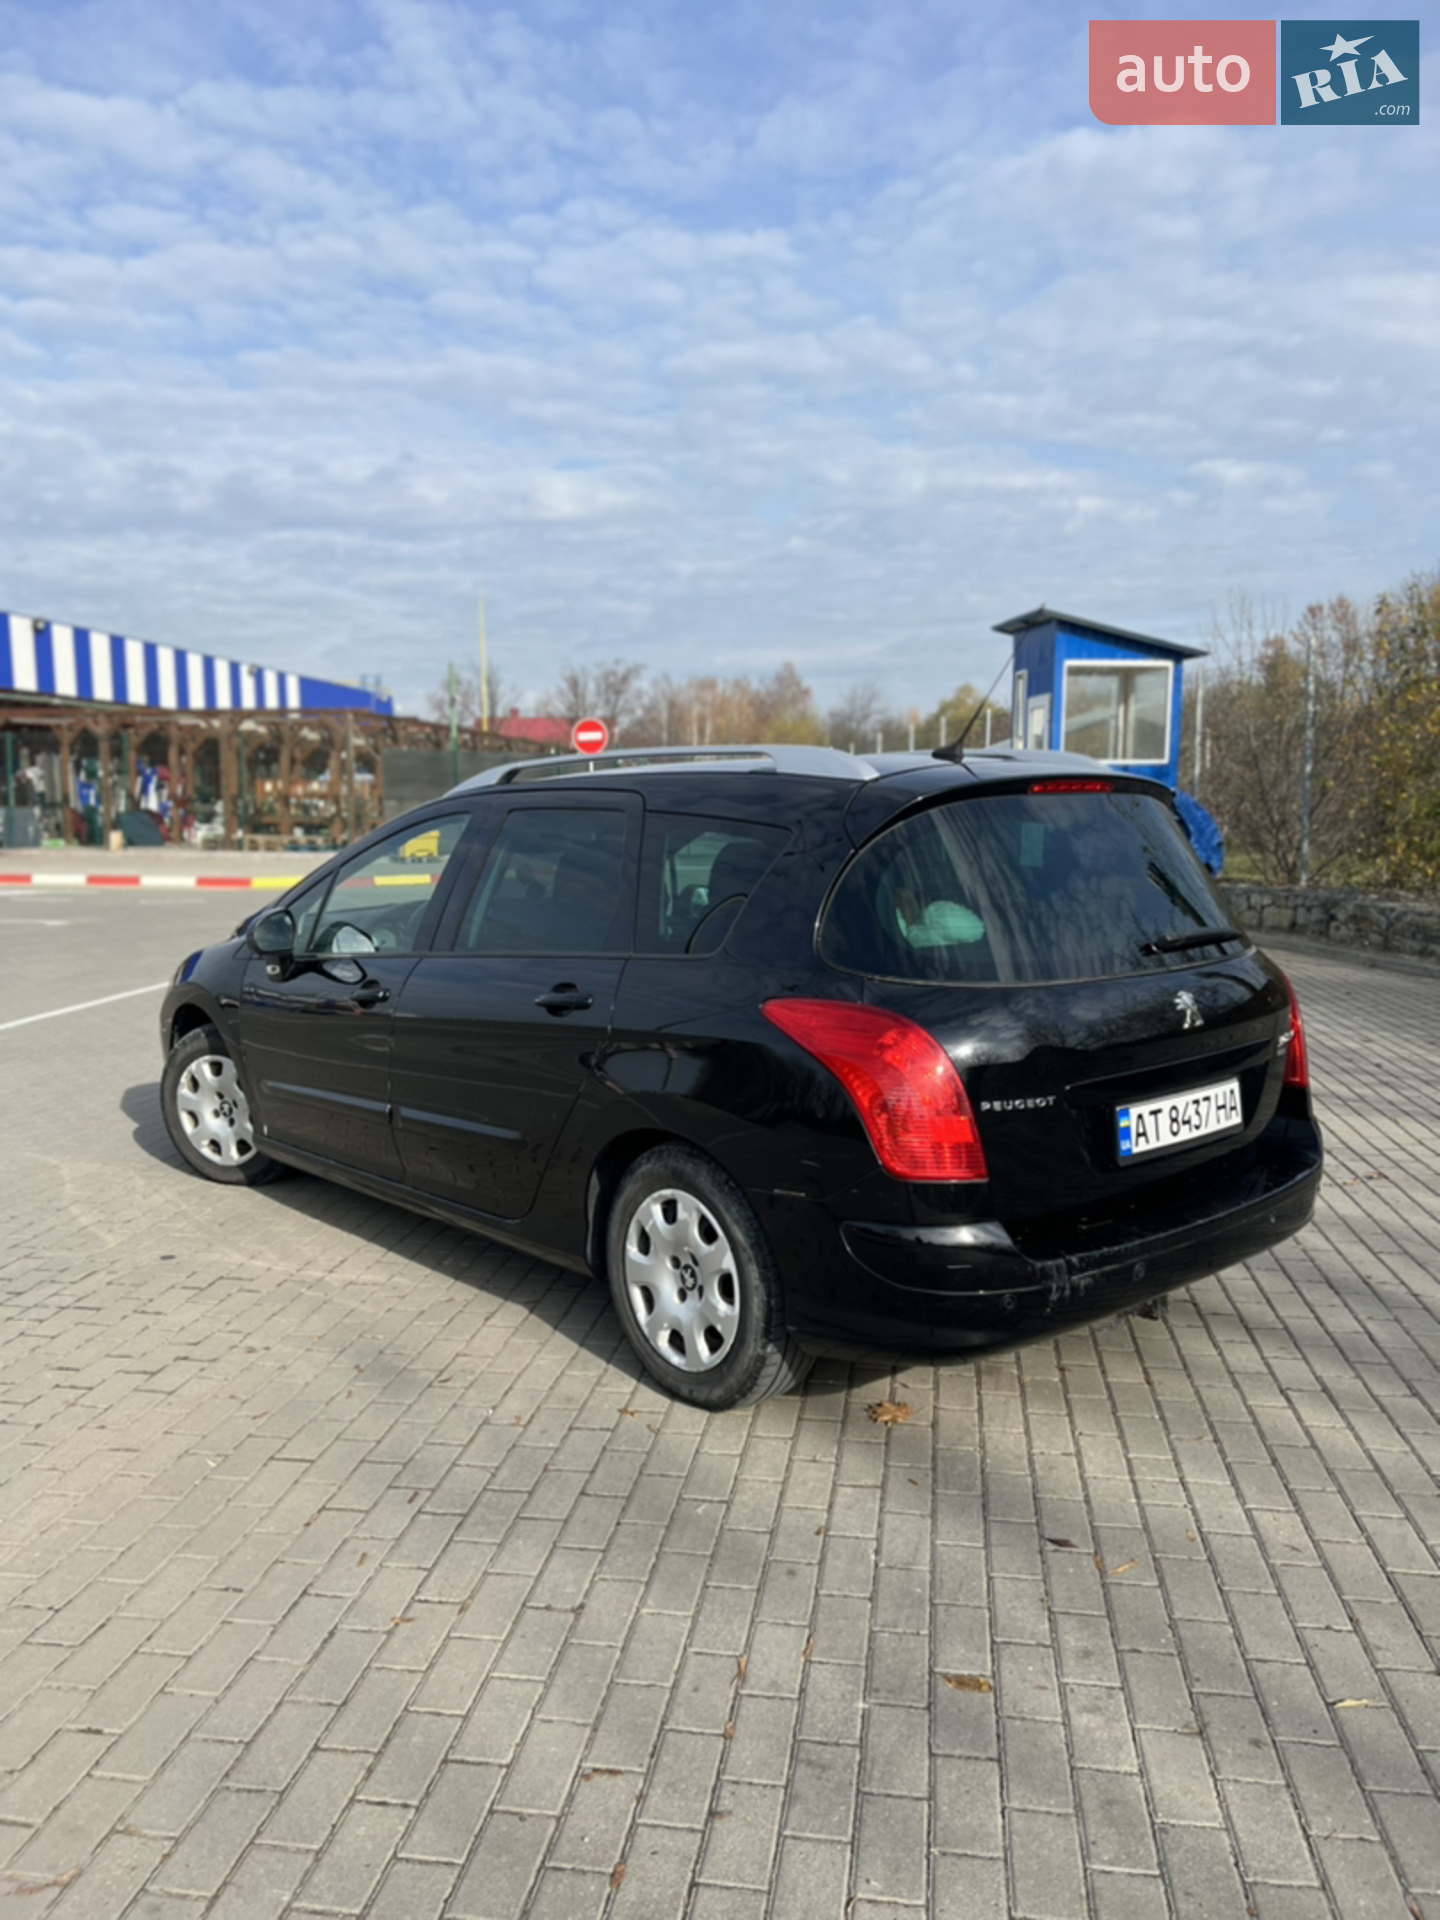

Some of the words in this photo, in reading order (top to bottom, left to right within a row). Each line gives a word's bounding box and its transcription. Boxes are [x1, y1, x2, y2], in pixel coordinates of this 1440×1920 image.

[980, 1095, 1057, 1111] PEUGEOT
[1134, 1108, 1163, 1148] AT
[1168, 1095, 1211, 1137] 8437
[1215, 1088, 1240, 1125] HA
